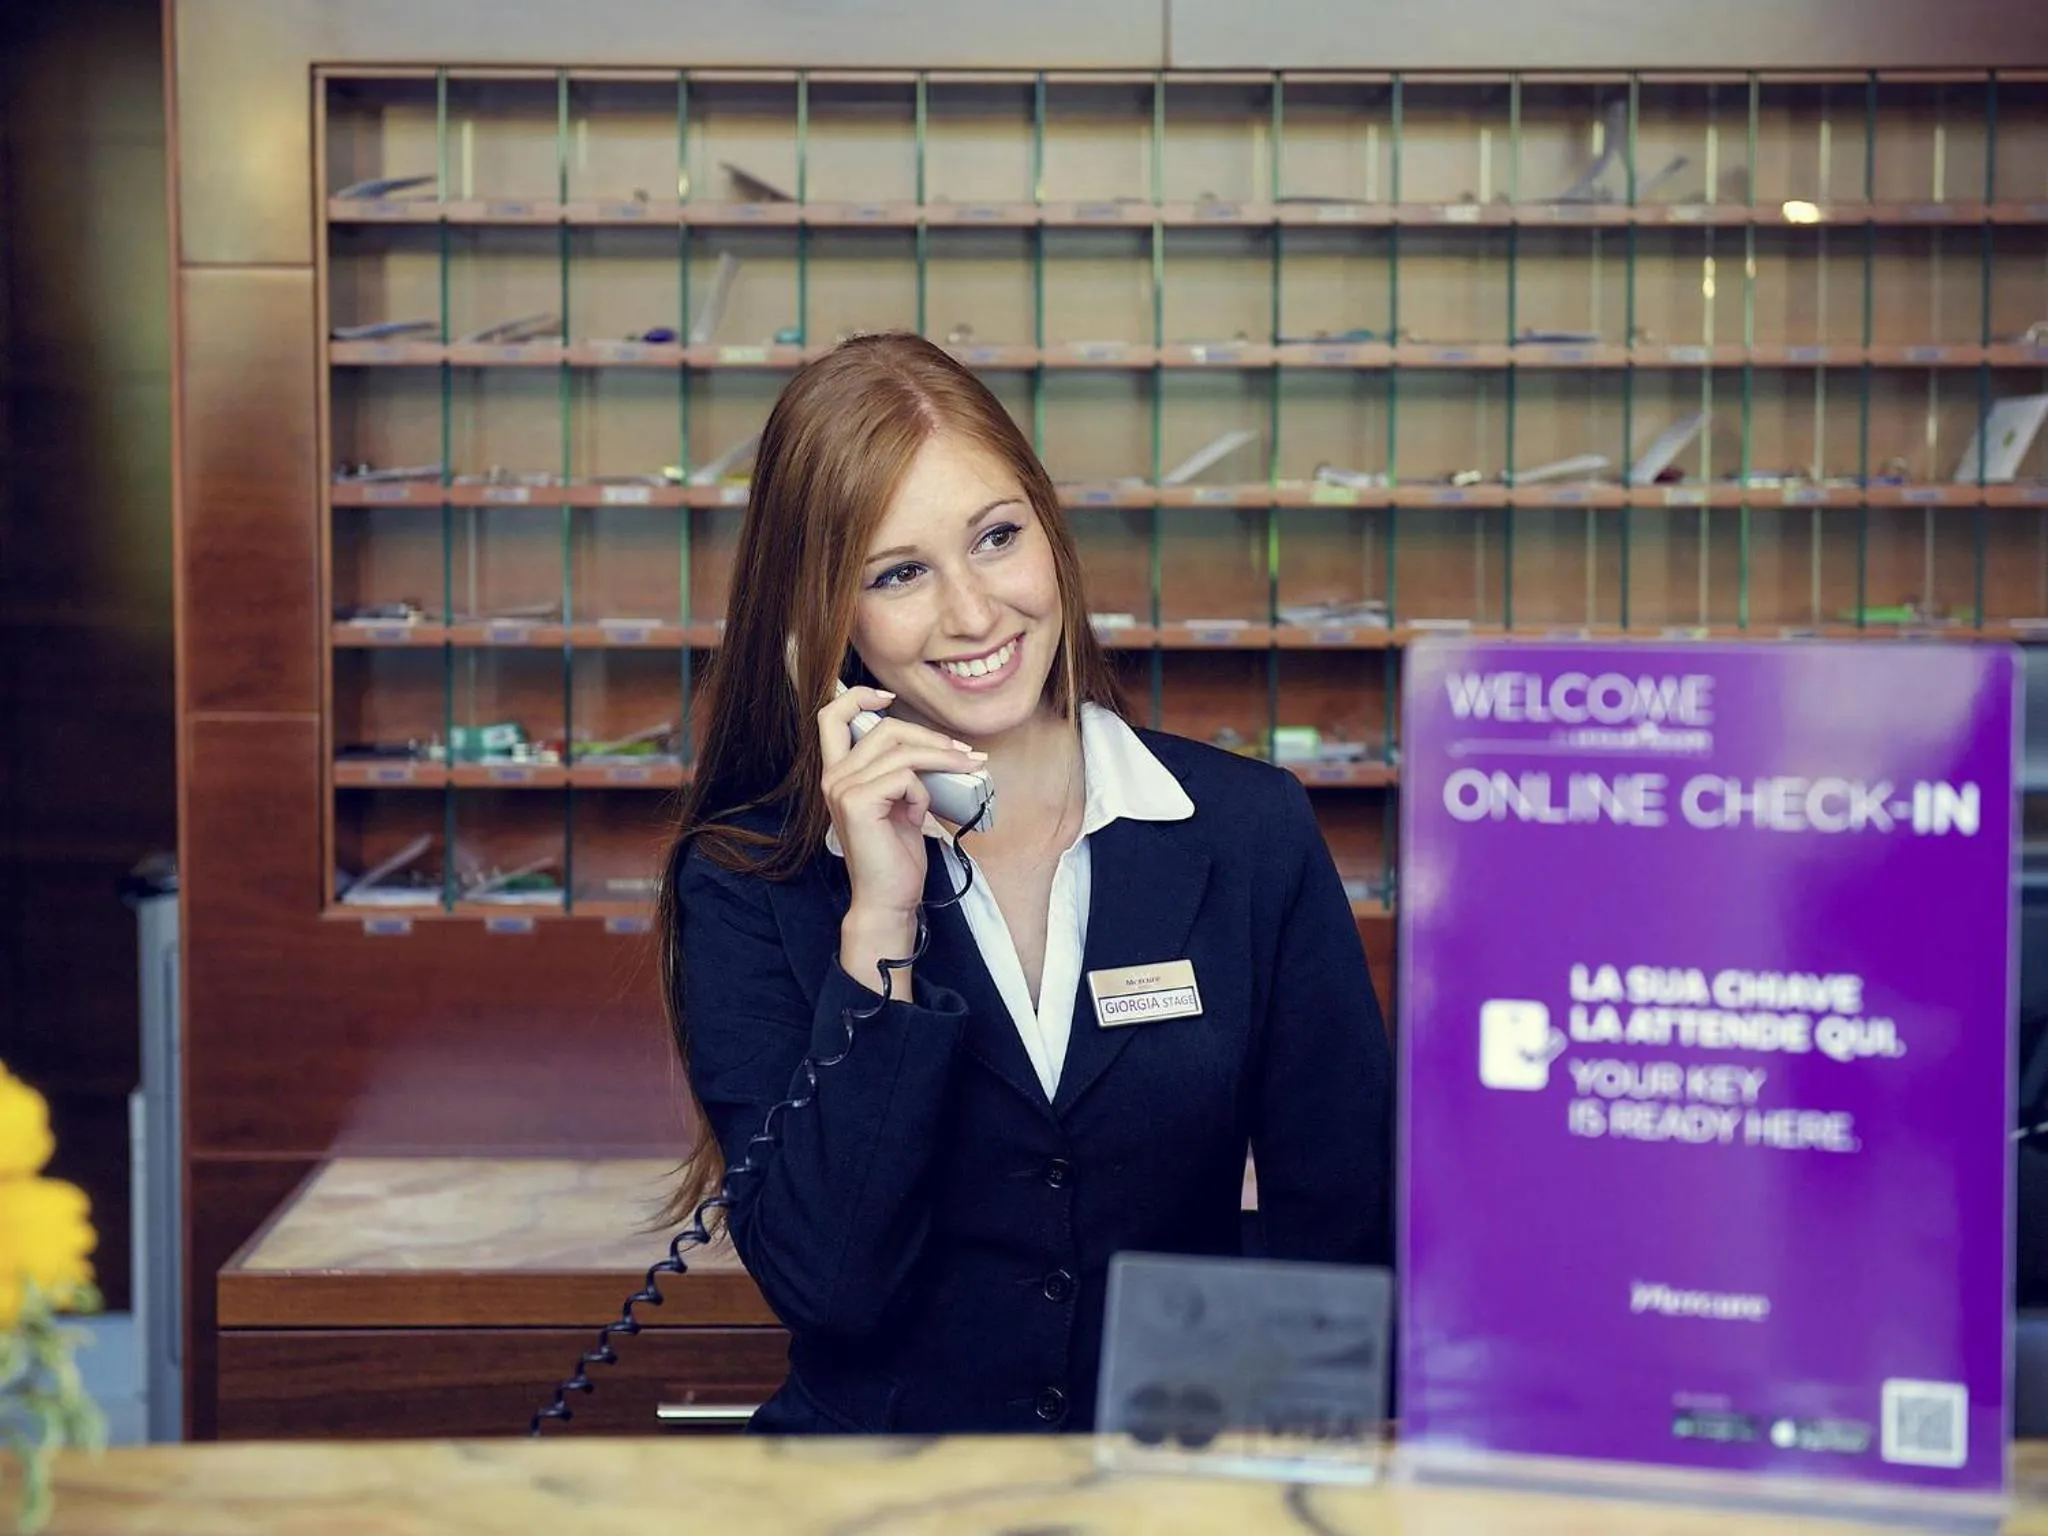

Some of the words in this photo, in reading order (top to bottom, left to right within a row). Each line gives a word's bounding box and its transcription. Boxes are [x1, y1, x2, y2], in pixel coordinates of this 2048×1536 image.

[1446, 672, 1714, 724] WELCOME
[1443, 769, 1668, 825] ONLINE
[1682, 775, 1981, 834] CHECK-IN
[1105, 997, 1160, 1014] GIORGIA
[1570, 963, 1624, 1002] LA
[1625, 965, 1710, 1005] SUA
[1711, 969, 1863, 1012] CHIAVE
[1570, 1003, 1624, 1043] LA
[1625, 1007, 1813, 1052] ATTENDE
[1570, 1057, 1685, 1099] YOUR
[1686, 1063, 1767, 1104] KEY
[1569, 1098, 1607, 1137] IS
[1608, 1099, 1743, 1143] READY
